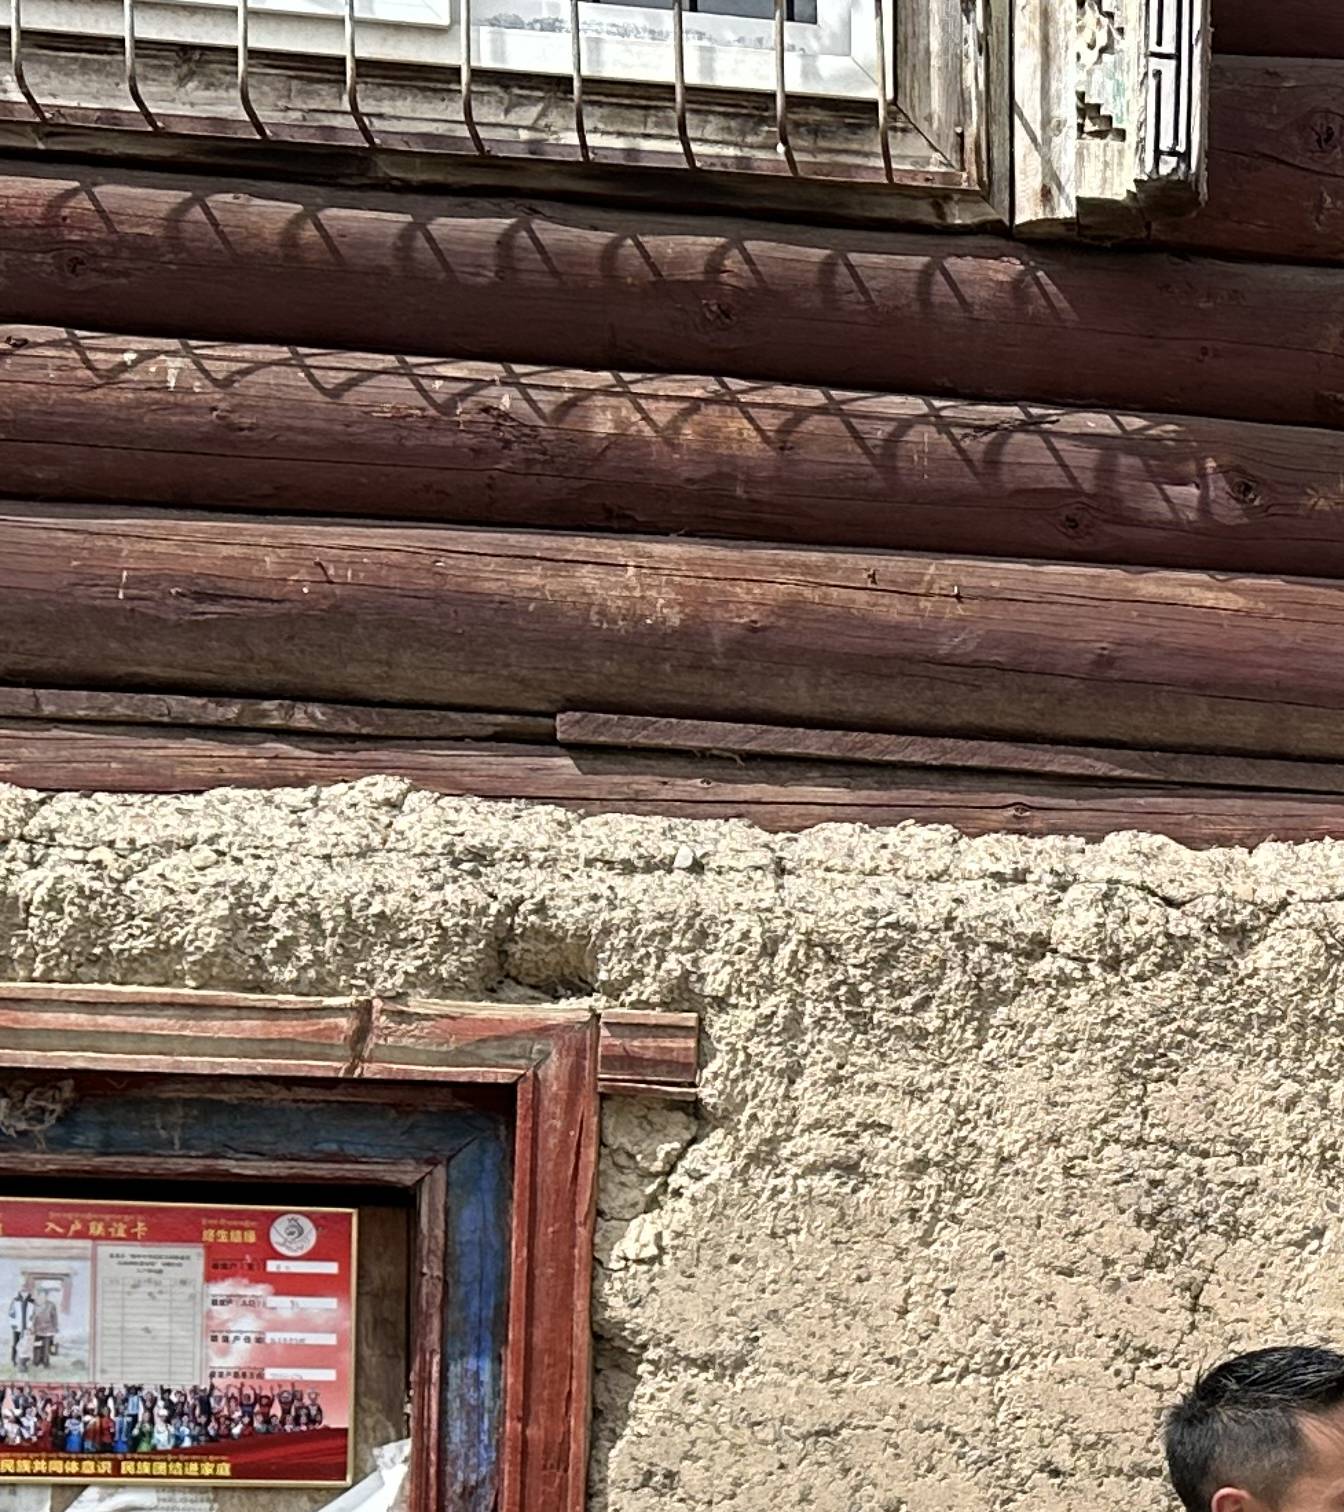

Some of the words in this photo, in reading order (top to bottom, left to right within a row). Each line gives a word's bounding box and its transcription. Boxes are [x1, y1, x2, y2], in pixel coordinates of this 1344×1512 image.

[44, 1219, 148, 1240] 入户联谊卡
[0, 1459, 112, 1473] 民族共同体意识
[121, 1461, 231, 1476] 民族团结进家庭
